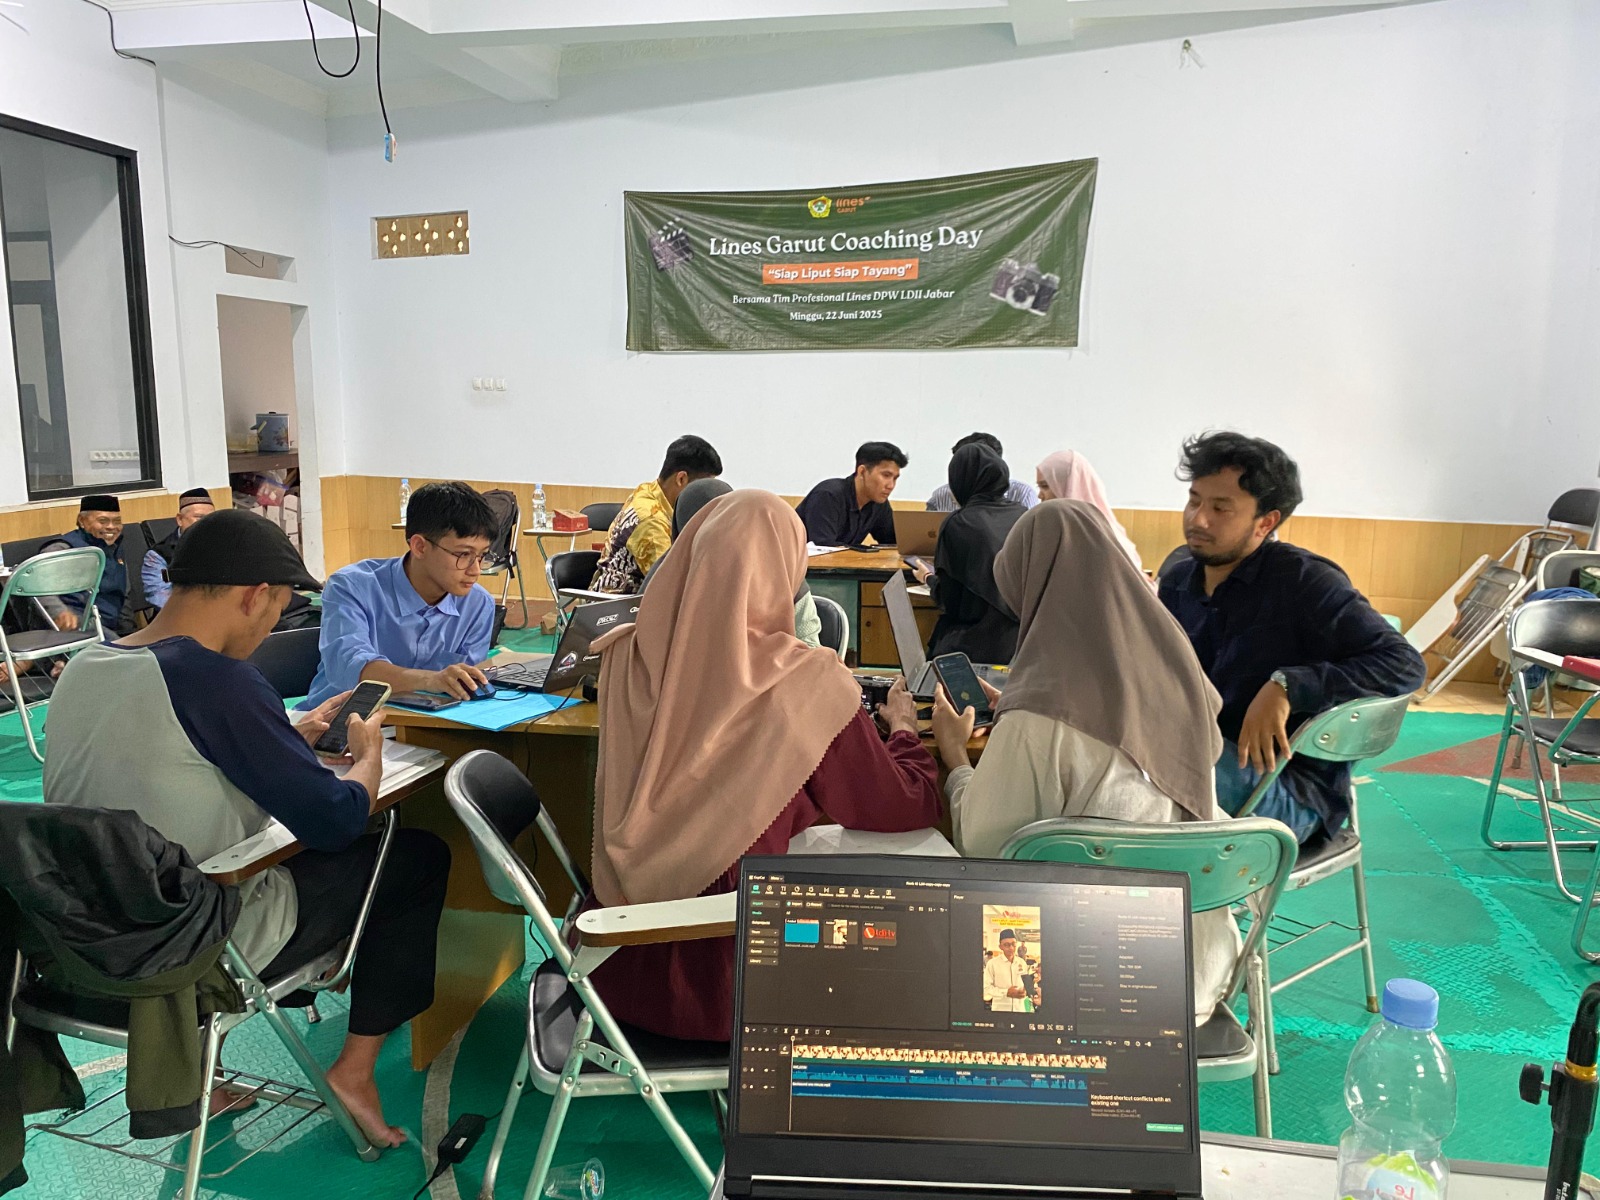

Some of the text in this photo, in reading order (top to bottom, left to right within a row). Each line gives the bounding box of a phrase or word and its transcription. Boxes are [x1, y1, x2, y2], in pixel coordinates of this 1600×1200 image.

[709, 226, 983, 256] Lines Garut Coaching Day
[801, 267, 831, 280] Liput
[834, 266, 859, 279] Siap
[732, 289, 955, 304] Bersama Tim Profesional Lines DPW LDII Jabar
[789, 310, 882, 322] Minggu, 22 Juni 2025
[1090, 1094, 1113, 1102] Keyboard
